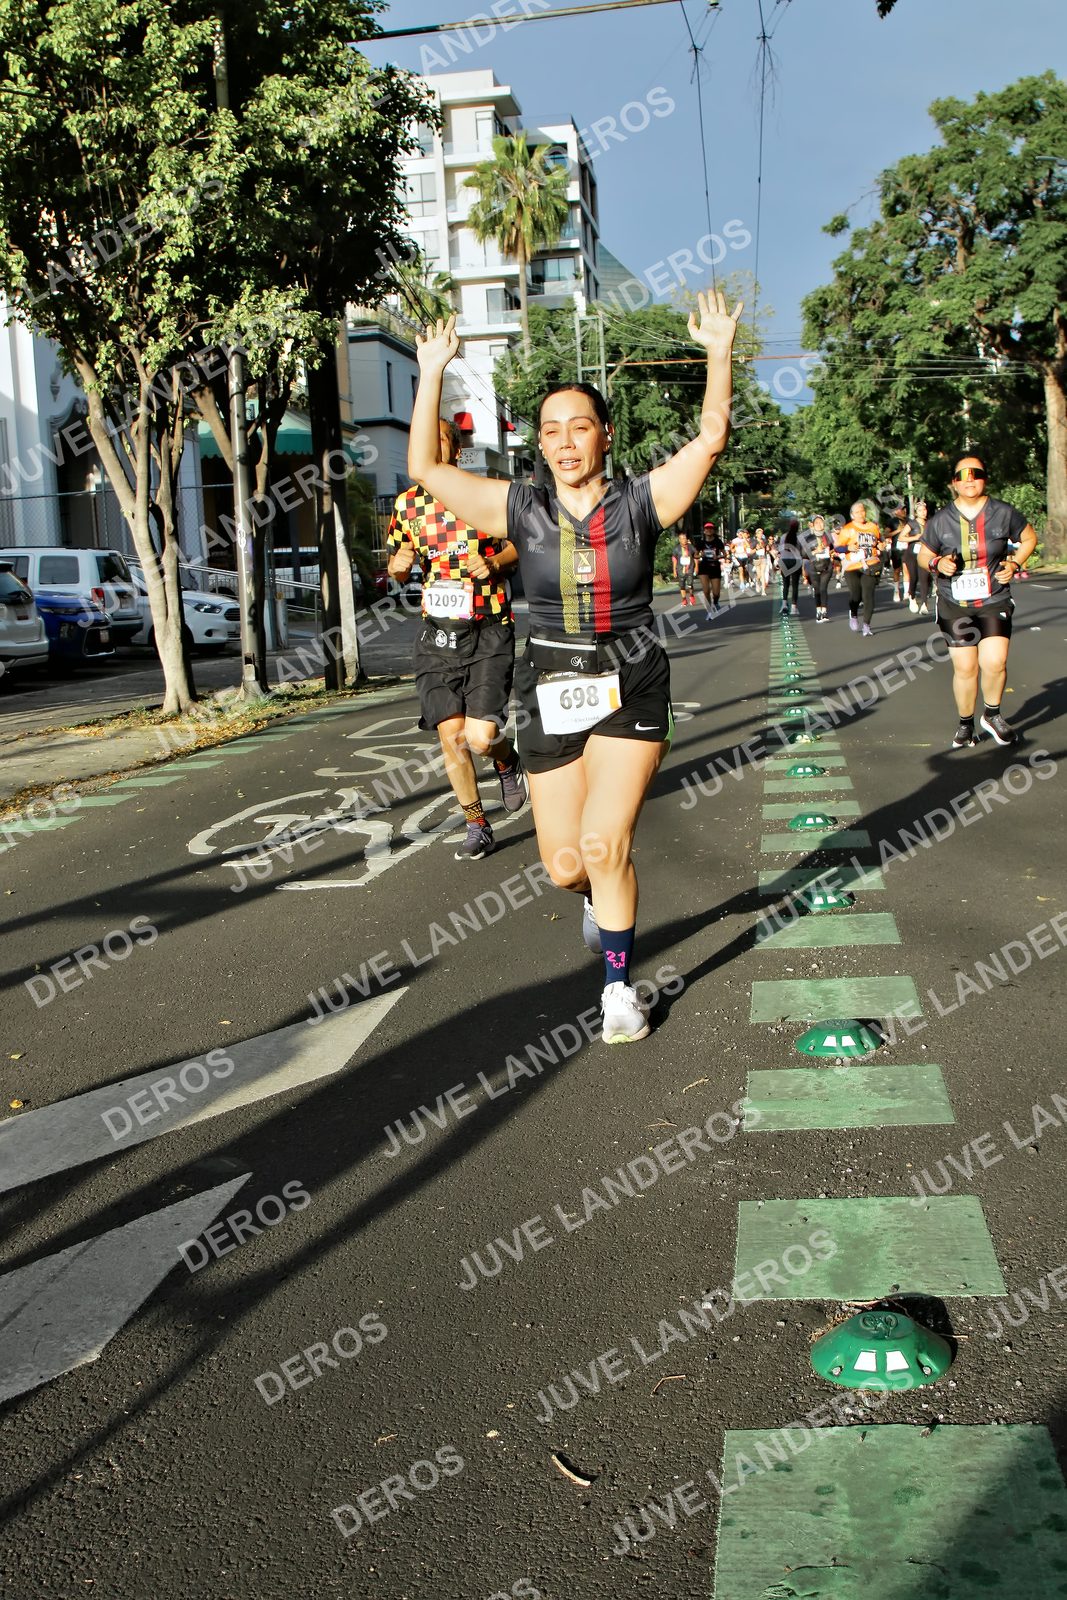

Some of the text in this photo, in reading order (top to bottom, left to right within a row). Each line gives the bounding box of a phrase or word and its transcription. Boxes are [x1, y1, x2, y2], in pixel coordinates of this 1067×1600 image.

[955, 577, 986, 590] 11358
[427, 593, 466, 608] 12097
[559, 685, 600, 710] 698
[605, 950, 626, 962] 21
[612, 961, 626, 969] KM
